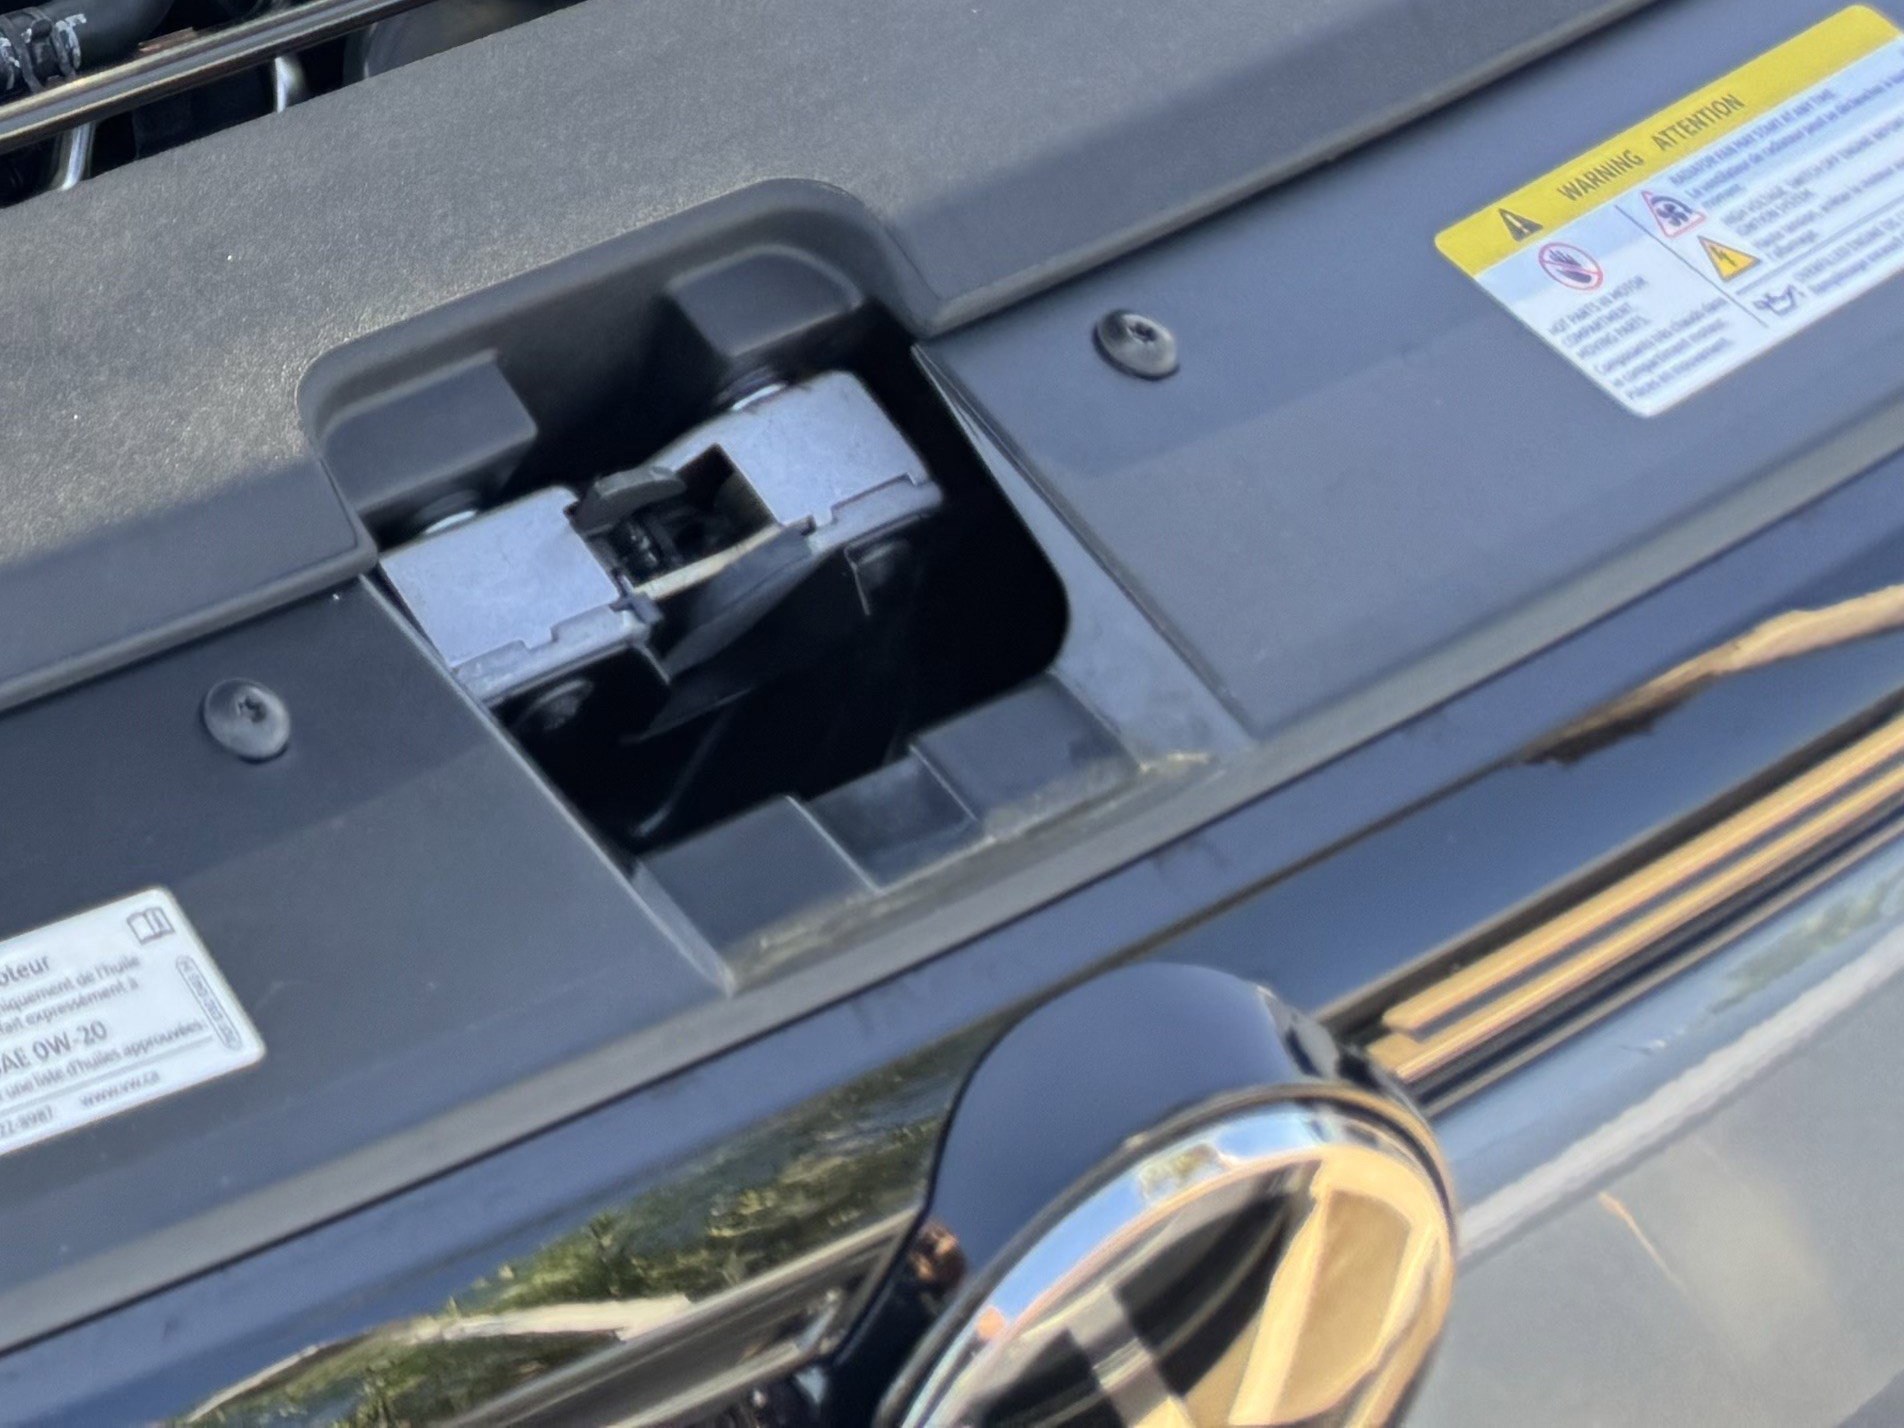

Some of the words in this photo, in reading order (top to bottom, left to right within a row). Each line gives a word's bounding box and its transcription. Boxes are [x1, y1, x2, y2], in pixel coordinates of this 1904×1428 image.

[1553, 147, 1647, 202] WARNING
[1645, 92, 1749, 152] ATTENTION
[28, 1017, 111, 1063] 0W-20
